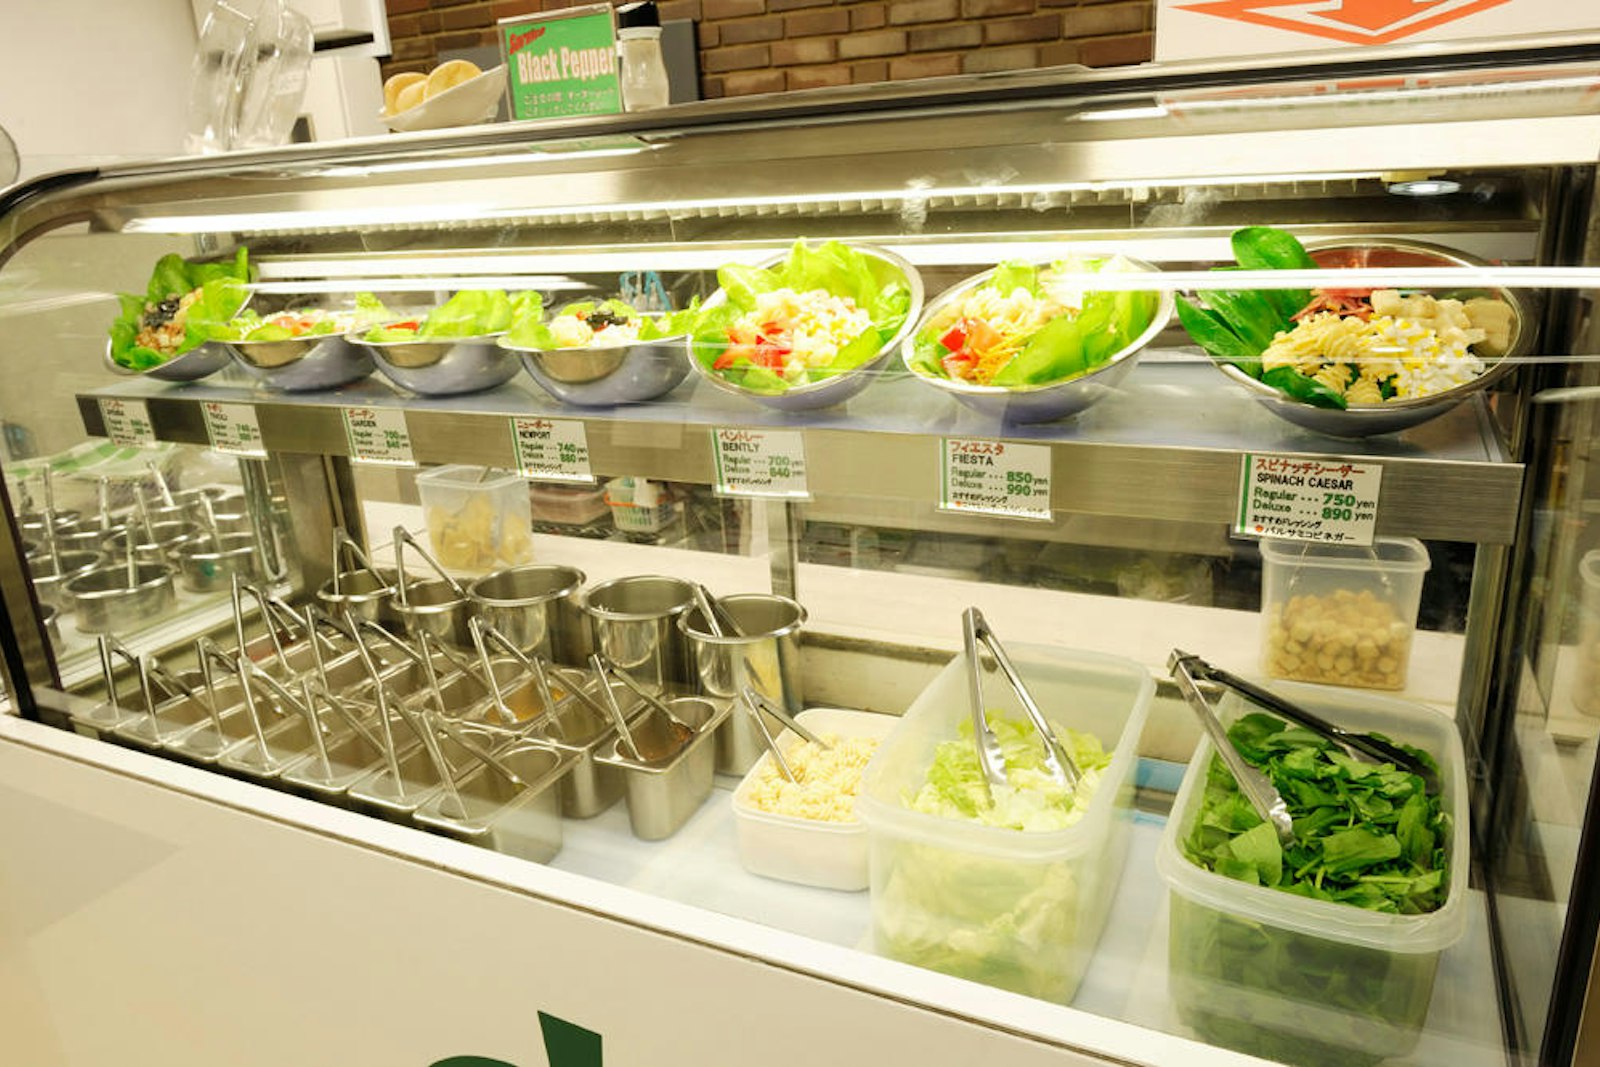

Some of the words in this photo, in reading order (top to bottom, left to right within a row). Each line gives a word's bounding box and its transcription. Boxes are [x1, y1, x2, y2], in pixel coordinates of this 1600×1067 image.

[517, 48, 561, 84] Black
[560, 46, 615, 82] Pepper
[519, 431, 551, 439] NEWPORT
[557, 442, 576, 453] 740
[722, 442, 760, 452] BENTLY
[950, 441, 1004, 456] フィエスタ
[560, 453, 576, 463] 880
[768, 455, 790, 466] 700
[952, 454, 994, 466] FIESTA
[769, 467, 790, 478] 840
[951, 466, 987, 479] Regular
[1006, 471, 1033, 484] 850
[1033, 477, 1048, 486] yen
[1255, 458, 1366, 479] スピナッチシーザー
[951, 477, 983, 489] Deluxe
[1006, 484, 1032, 496] 990
[1033, 488, 1048, 497] yen
[1257, 473, 1305, 487] SPINACH
[1308, 477, 1354, 491] CAESAR
[1254, 486, 1298, 501] Regular
[1322, 492, 1356, 507] 750
[1356, 499, 1375, 510] yen
[1253, 499, 1292, 513] Deluxe
[1321, 507, 1352, 521] 890
[1354, 512, 1374, 522] yen
